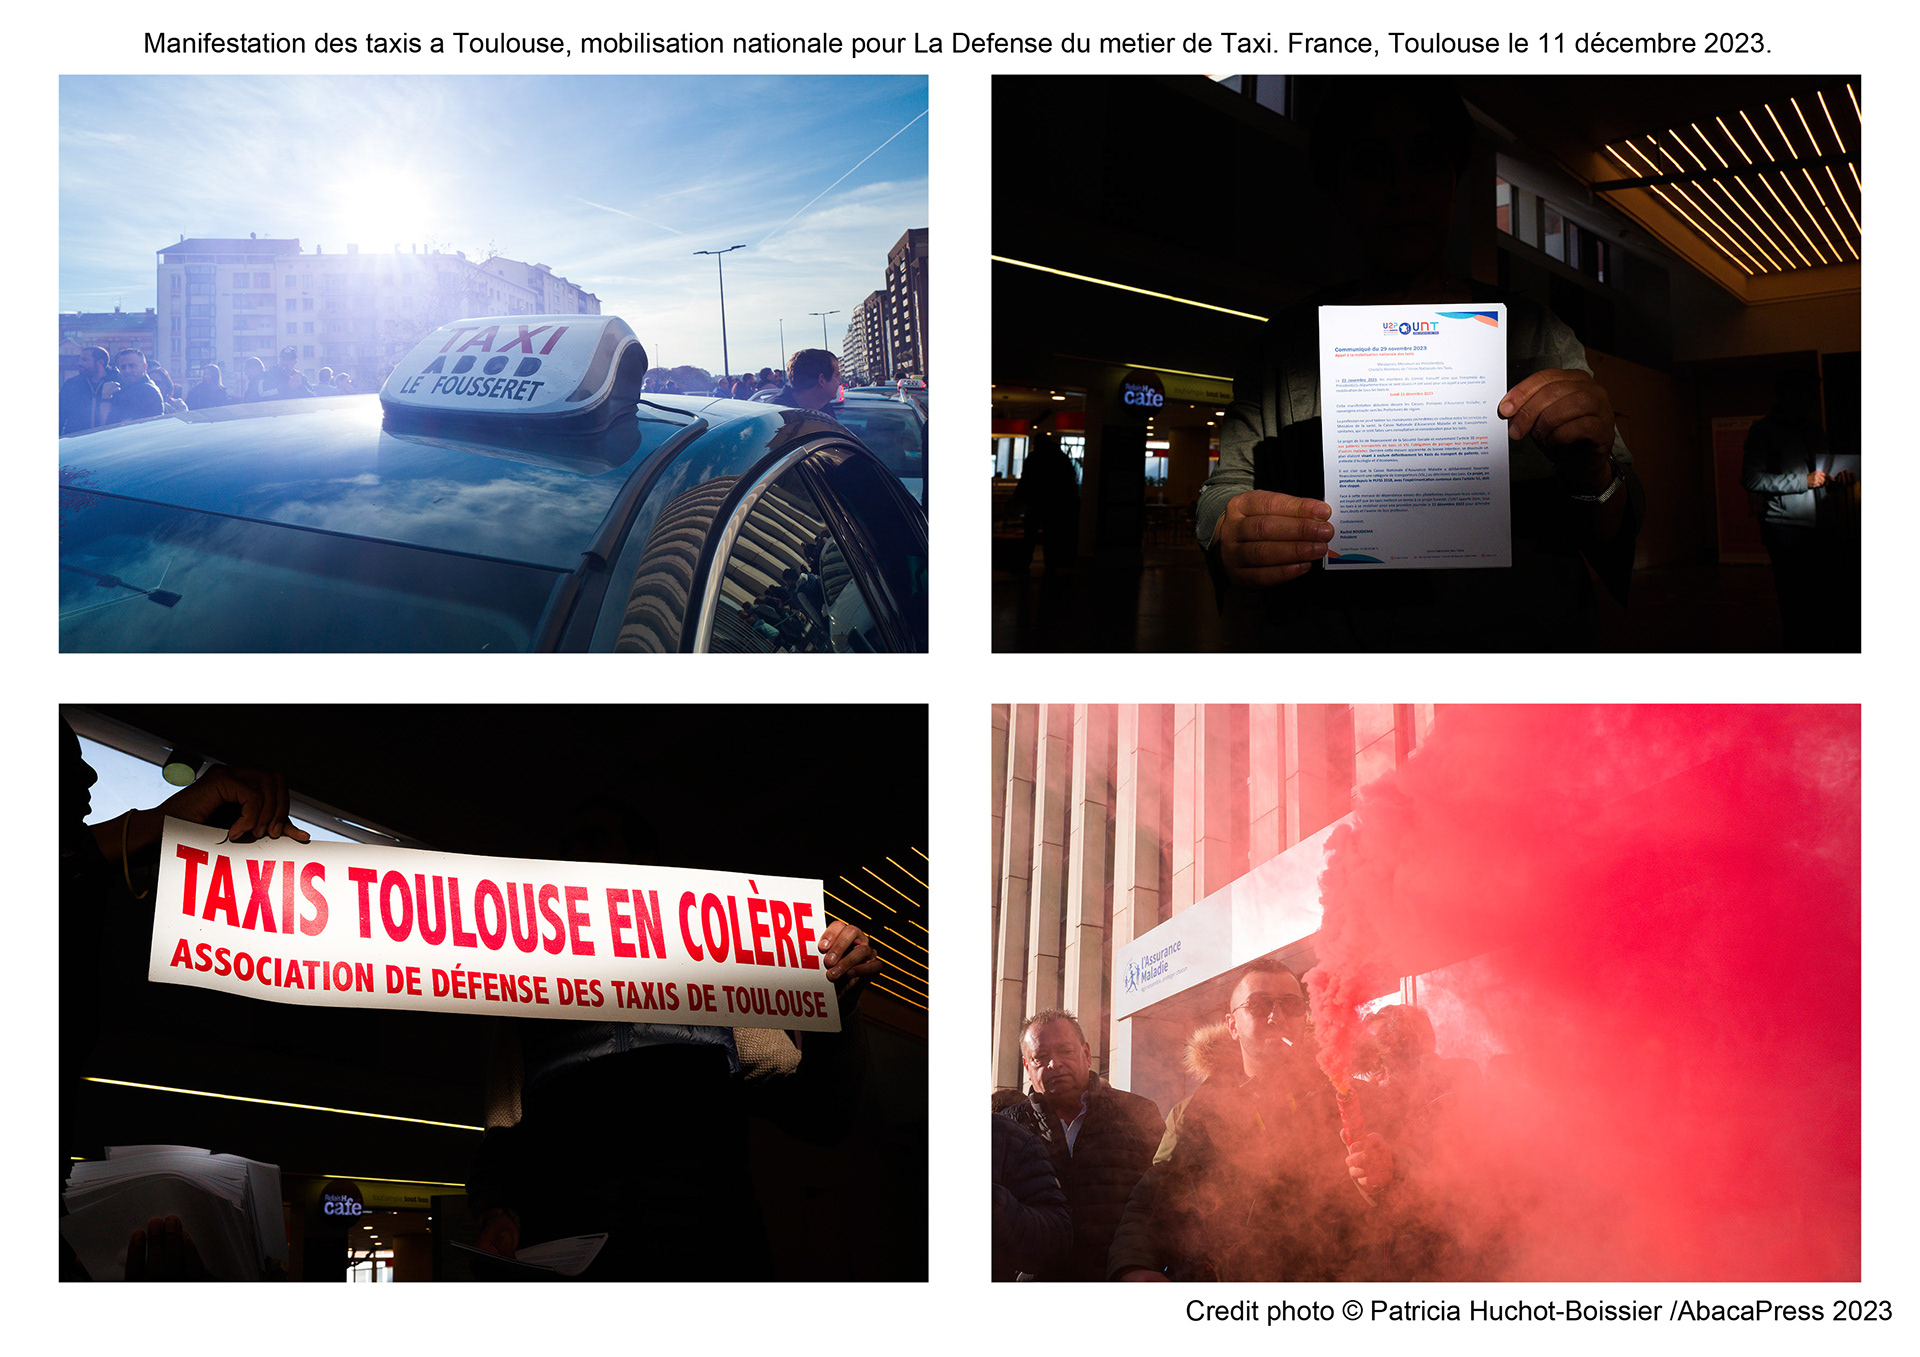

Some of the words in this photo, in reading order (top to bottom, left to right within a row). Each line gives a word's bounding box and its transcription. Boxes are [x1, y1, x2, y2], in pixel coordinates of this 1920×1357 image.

[439, 325, 569, 355] TAXI
[400, 376, 425, 394] LE
[431, 376, 546, 402] FOUSSERET
[176, 844, 328, 936] TAXIS
[348, 867, 595, 956] TOULOUSE
[606, 888, 667, 959] EN
[679, 879, 819, 970] COLÈRE
[1142, 940, 1181, 970] l'Assurance
[170, 938, 374, 992] ASSOCIATION
[386, 965, 422, 995] DE
[432, 963, 549, 1004] DÉFENSE
[557, 978, 604, 1007] DES
[611, 981, 680, 1010] TAXIS
[688, 983, 717, 1013] DE
[722, 984, 828, 1018] TOULOUSE
[1141, 960, 1168, 984] Maladie
